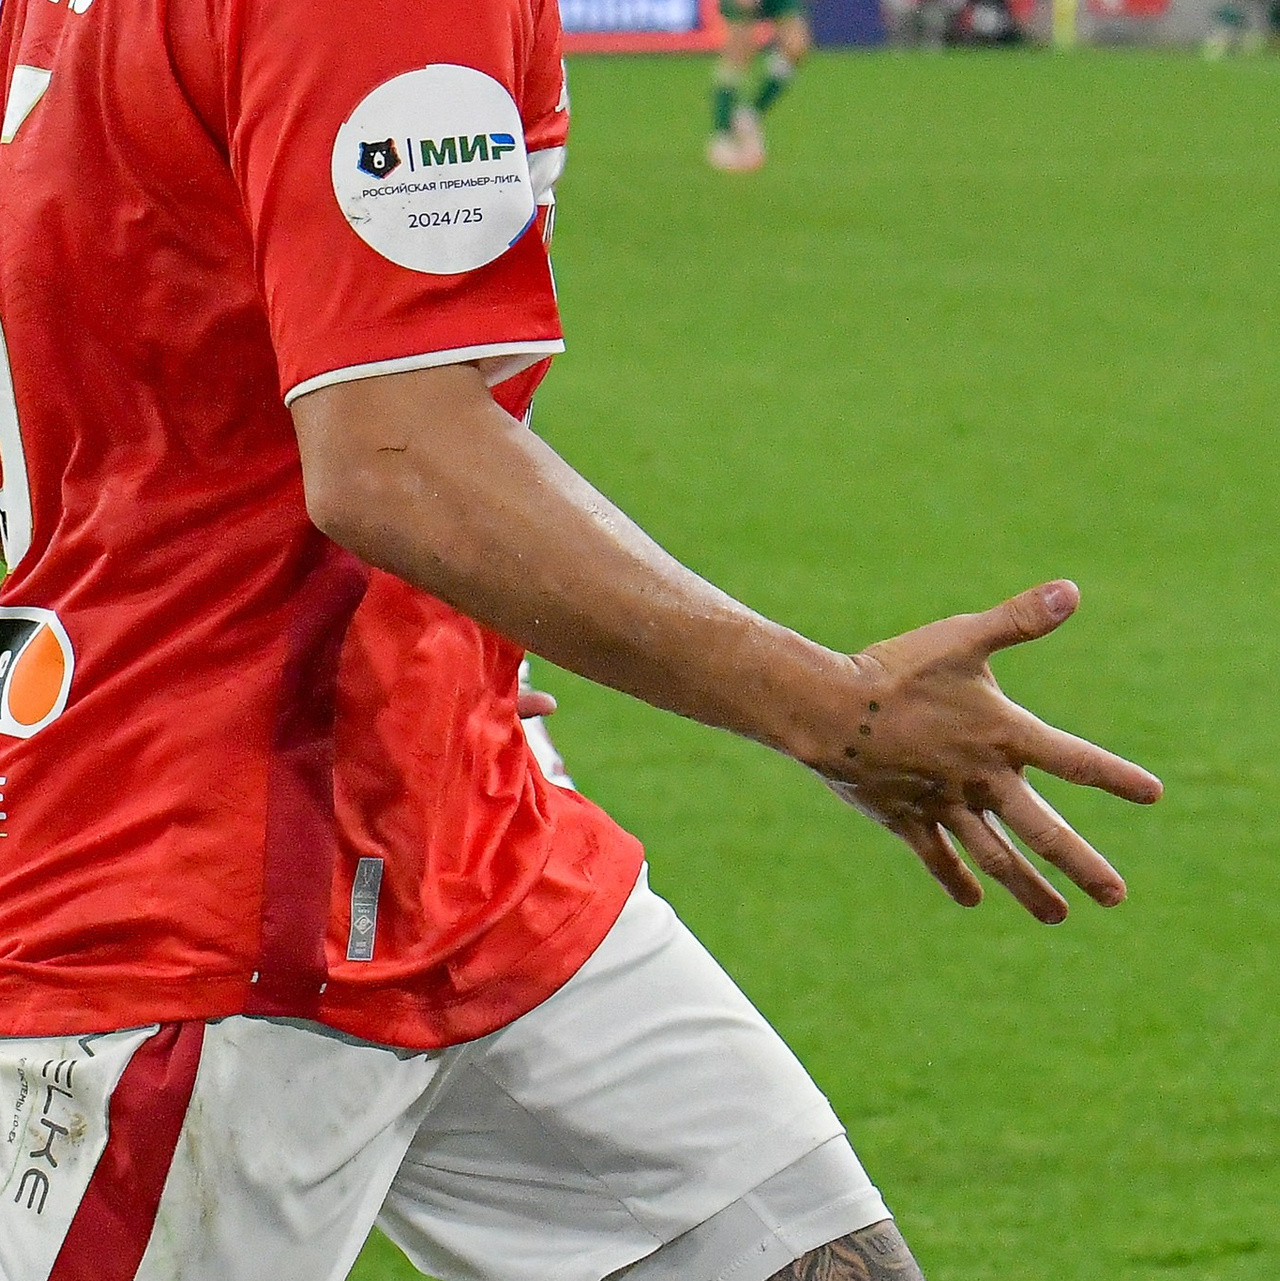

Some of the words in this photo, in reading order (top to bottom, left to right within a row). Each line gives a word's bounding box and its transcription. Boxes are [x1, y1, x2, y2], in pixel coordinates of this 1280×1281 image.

[420, 133, 516, 167] МИР
[362, 182, 437, 198] РОССИЙСКАЯ
[439, 174, 521, 190] ПРЕМЬЕР-ЛИГА
[408, 207, 483, 228] 2024/25
